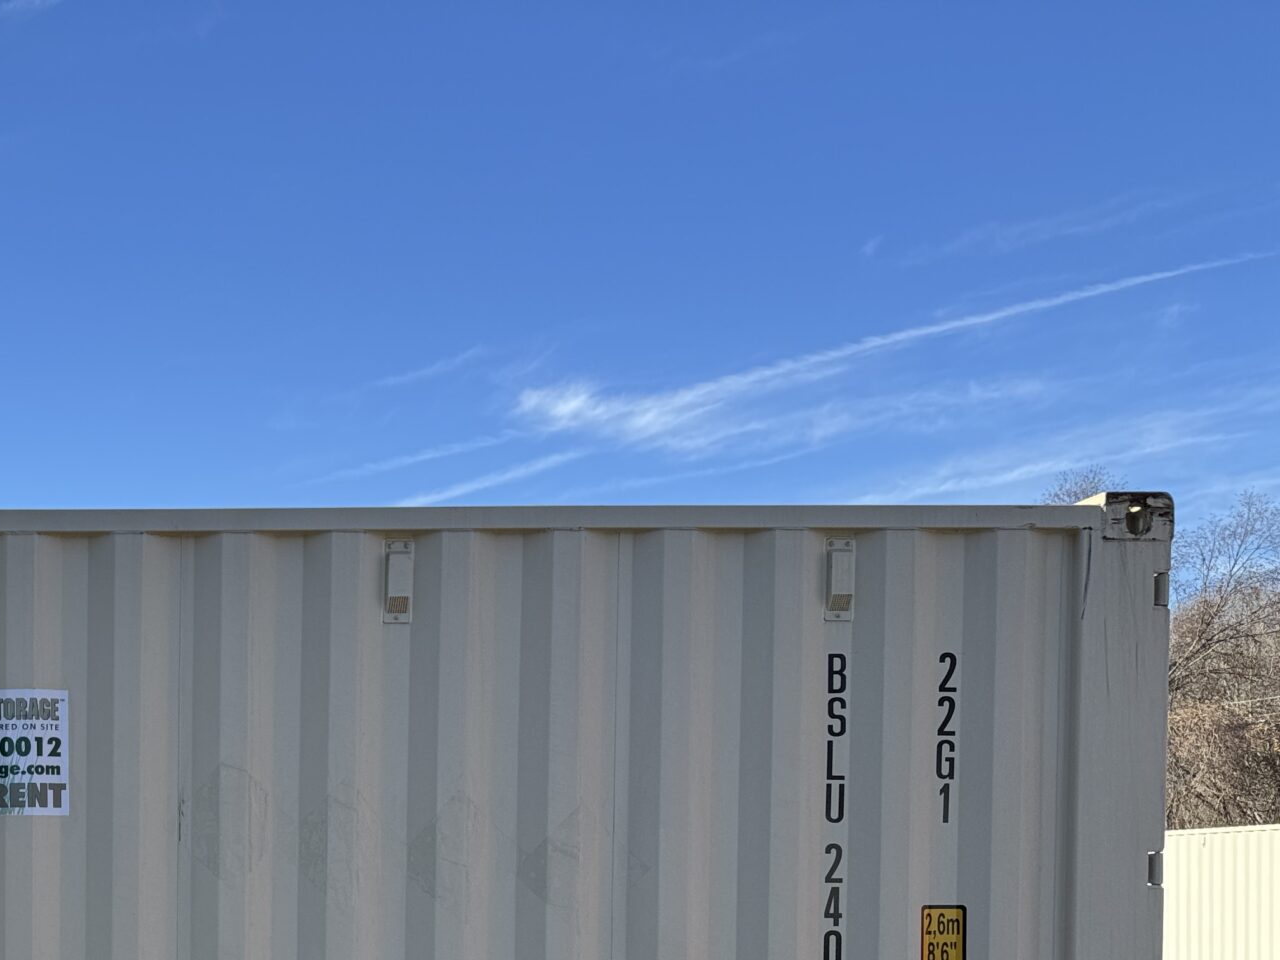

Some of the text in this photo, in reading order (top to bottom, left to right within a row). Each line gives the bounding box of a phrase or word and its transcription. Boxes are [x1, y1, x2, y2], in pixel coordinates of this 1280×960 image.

[22, 723, 36, 731] ON
[40, 723, 60, 731] SITE
[825, 653, 847, 823] BSLU
[936, 652, 958, 823] 22G1
